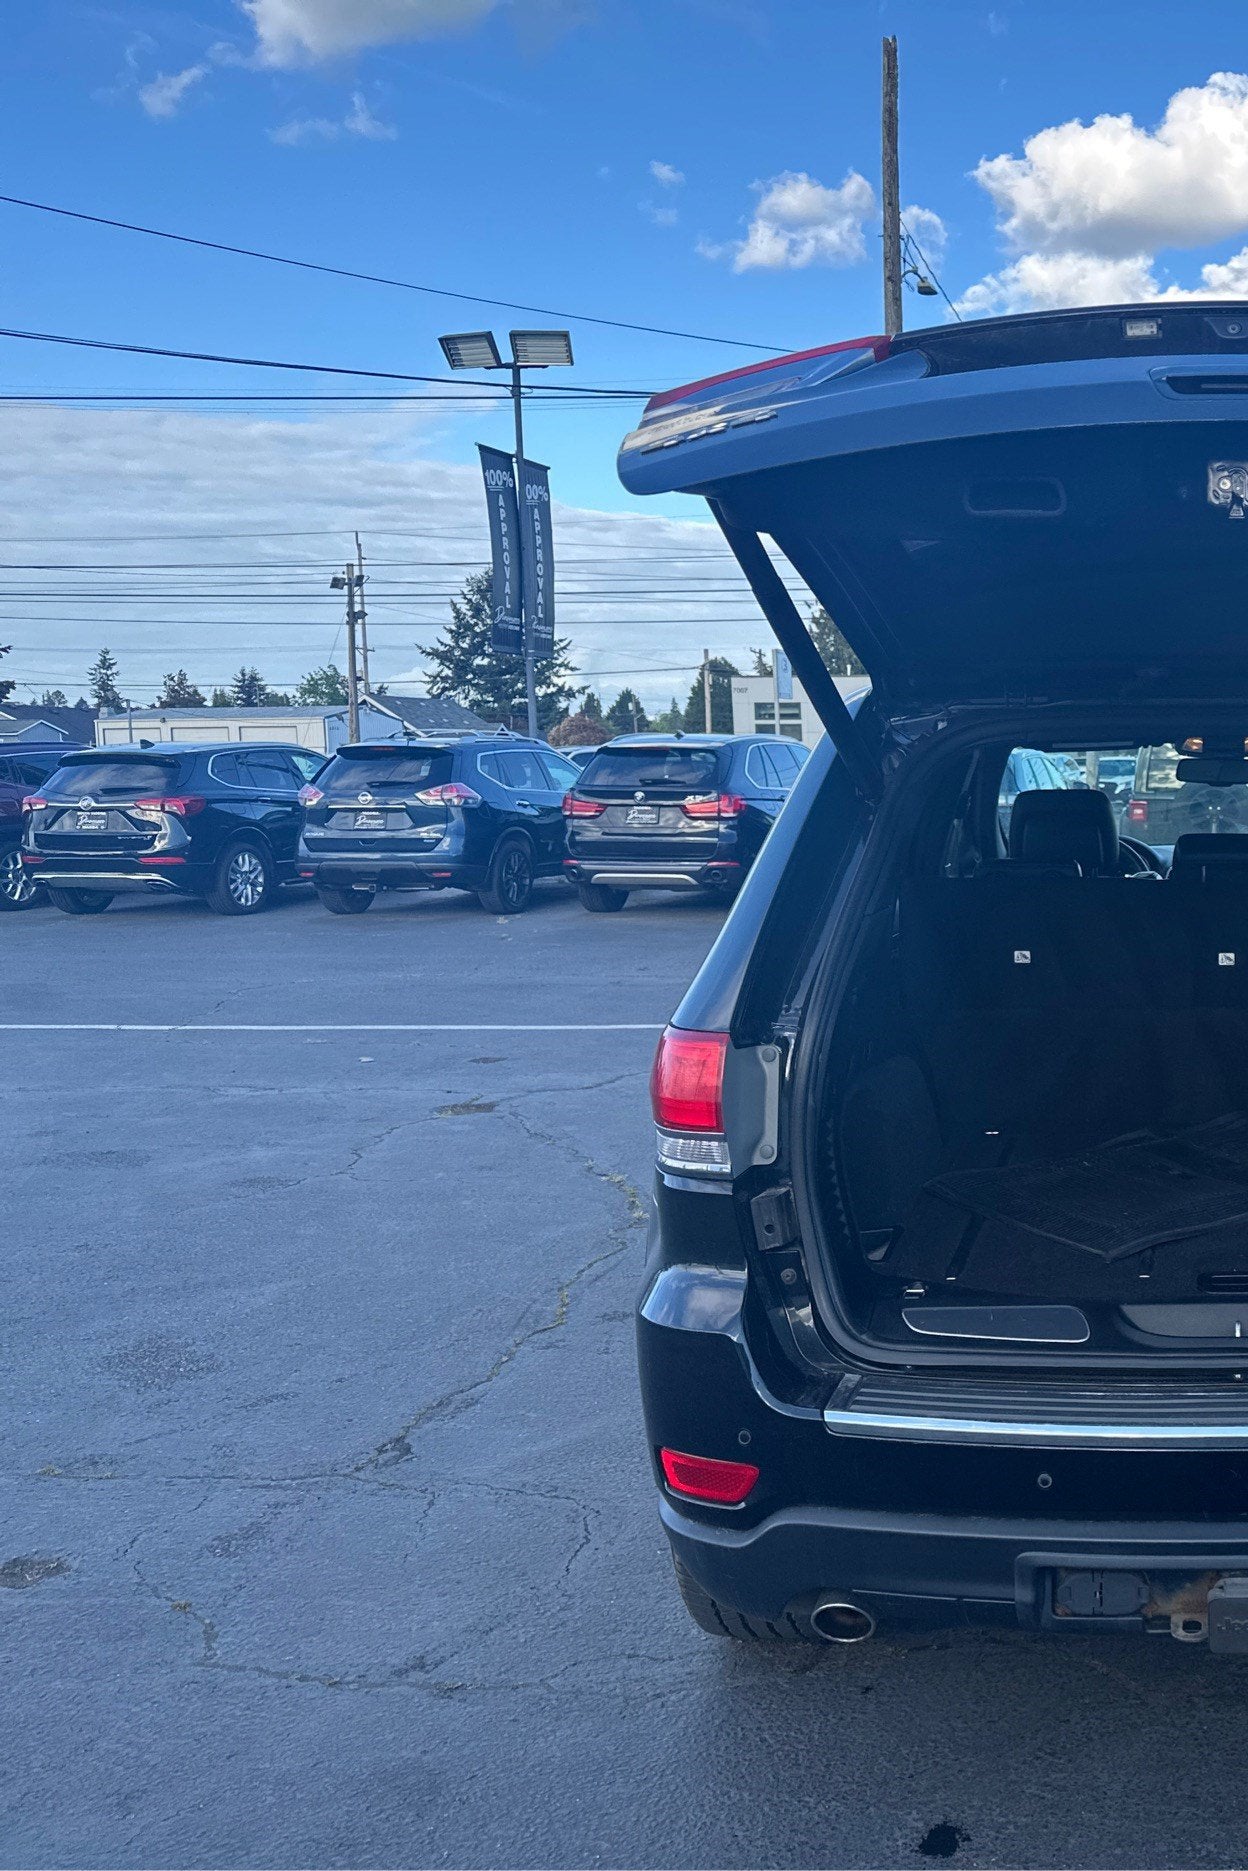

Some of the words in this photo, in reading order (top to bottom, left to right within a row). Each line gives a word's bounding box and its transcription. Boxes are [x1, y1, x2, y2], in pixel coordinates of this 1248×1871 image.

[485, 469, 514, 488] 100%
[525, 483, 549, 502] 00%
[498, 494, 511, 609] APPROVAL
[534, 508, 544, 618] APPROVAL
